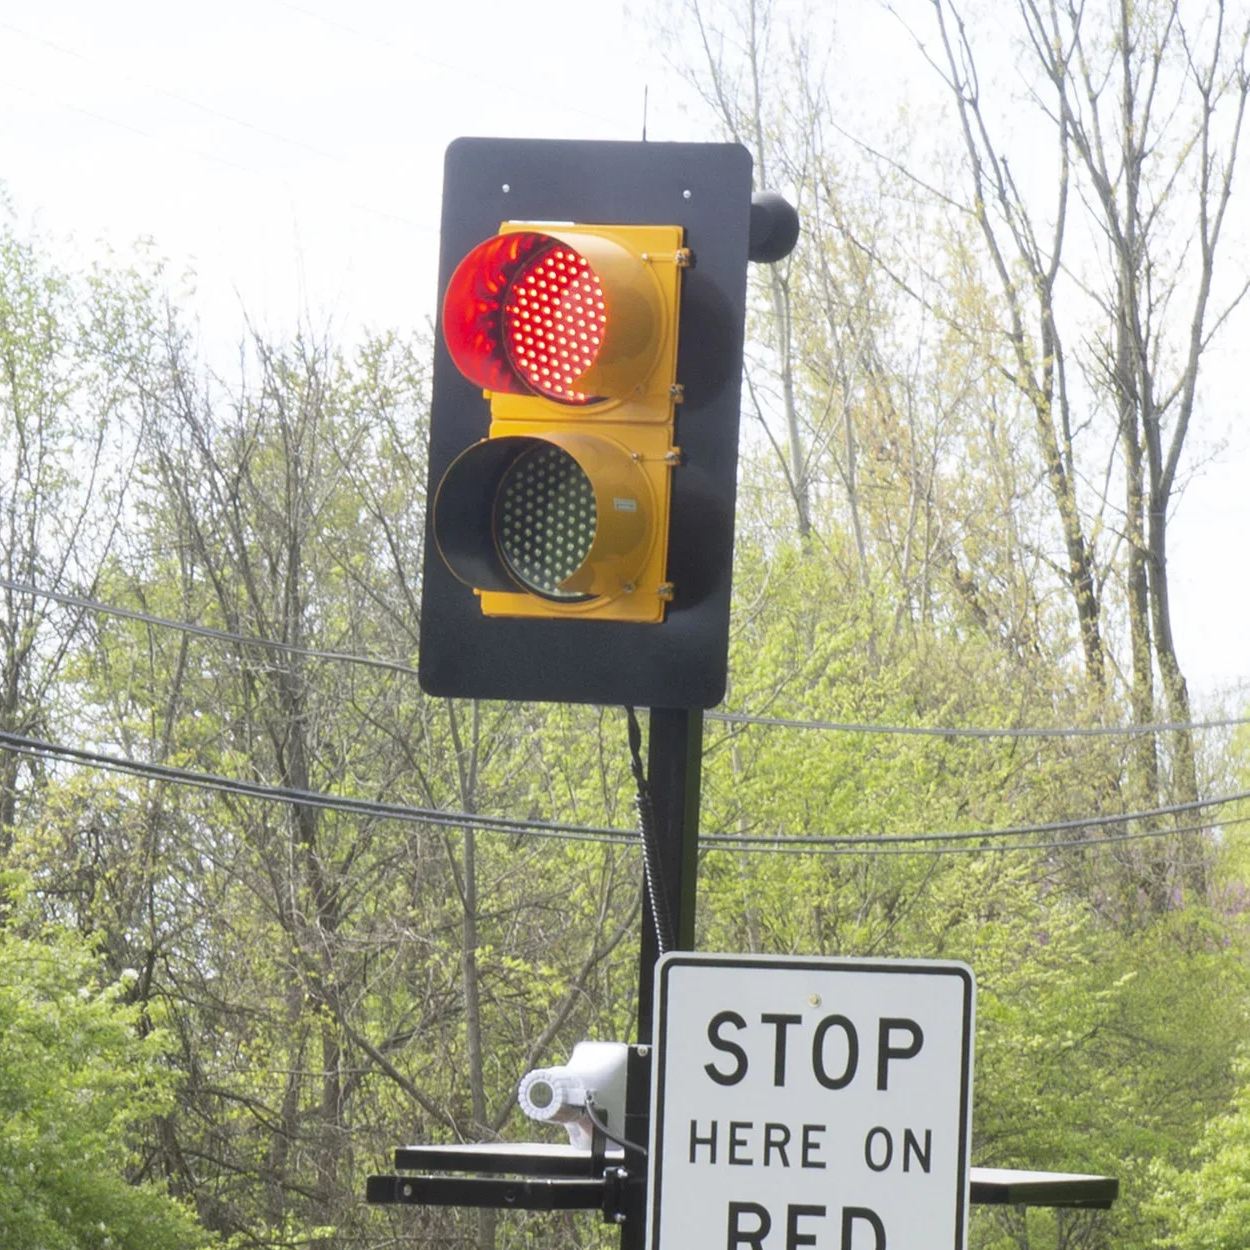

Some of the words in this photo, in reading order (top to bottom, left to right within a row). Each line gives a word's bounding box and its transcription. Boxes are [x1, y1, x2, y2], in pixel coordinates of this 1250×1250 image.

[704, 1010, 924, 1091] STOP
[689, 1119, 827, 1169] HERE
[864, 1126, 932, 1174] ON
